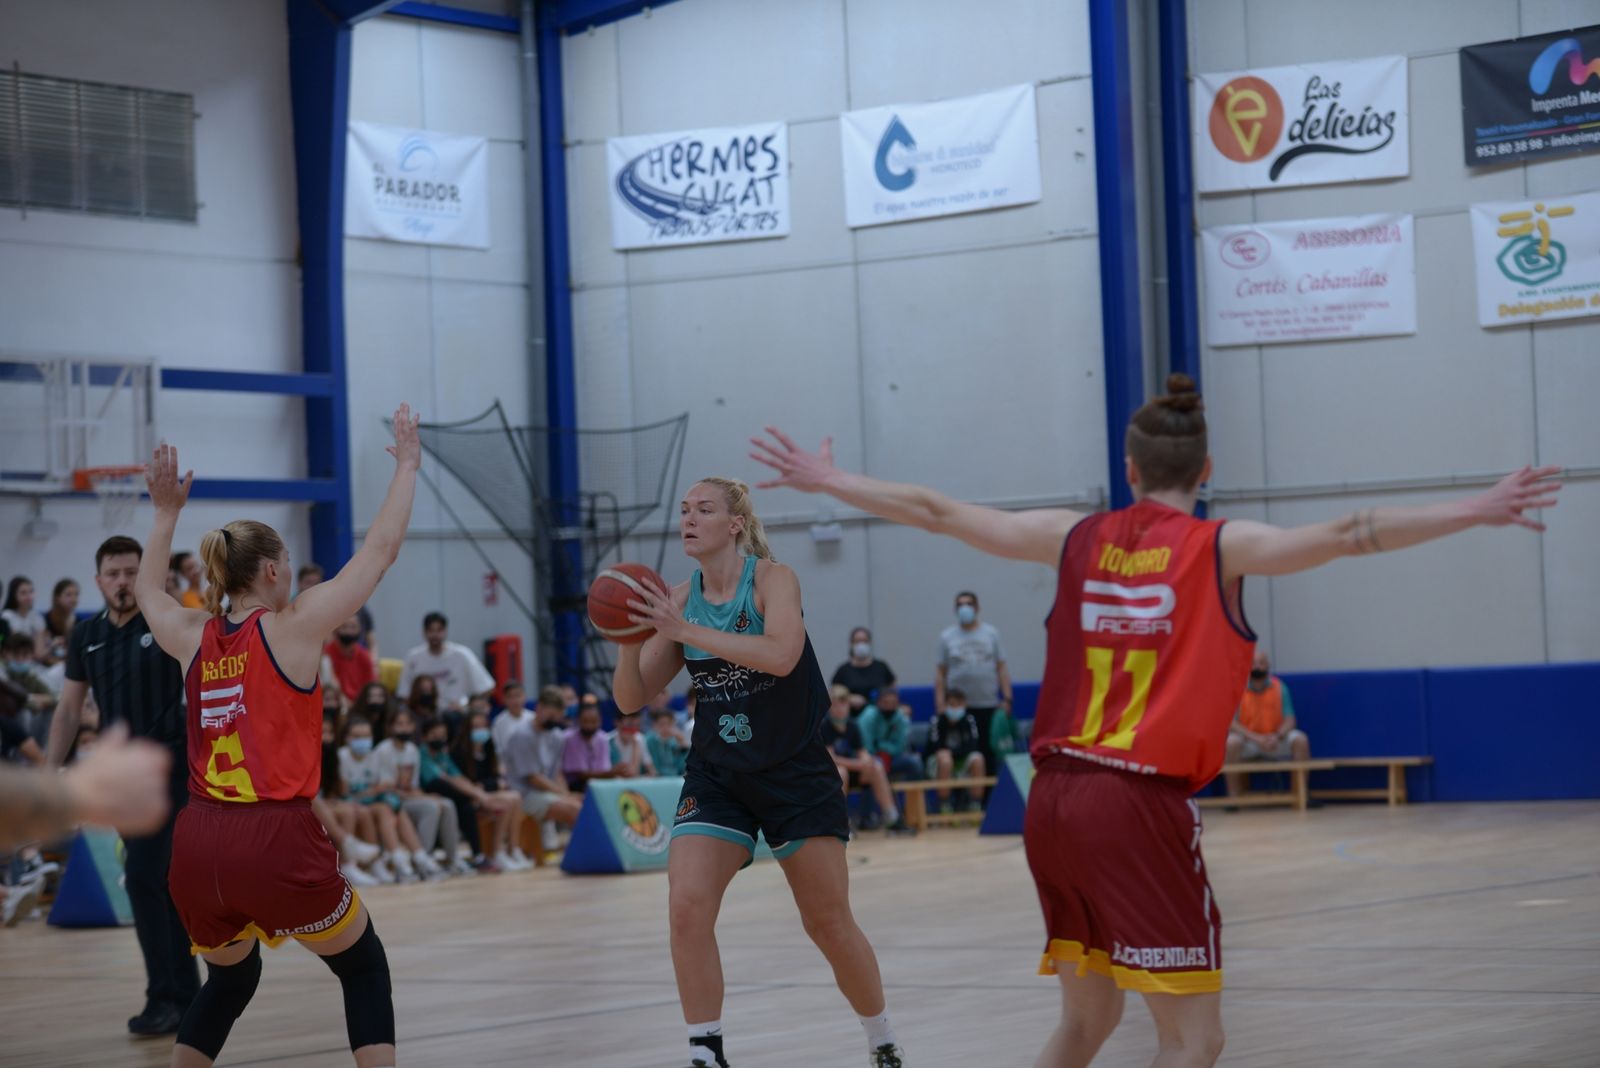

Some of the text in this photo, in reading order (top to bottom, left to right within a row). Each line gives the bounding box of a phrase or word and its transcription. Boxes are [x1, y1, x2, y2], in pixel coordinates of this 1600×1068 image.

[1531, 90, 1600, 113] Imprenta Me
[1288, 102, 1397, 146] delicias
[373, 176, 462, 203] PARADOR
[1068, 646, 1158, 751] 11
[719, 713, 752, 743] 26
[275, 886, 352, 937] ALCOBENDAS
